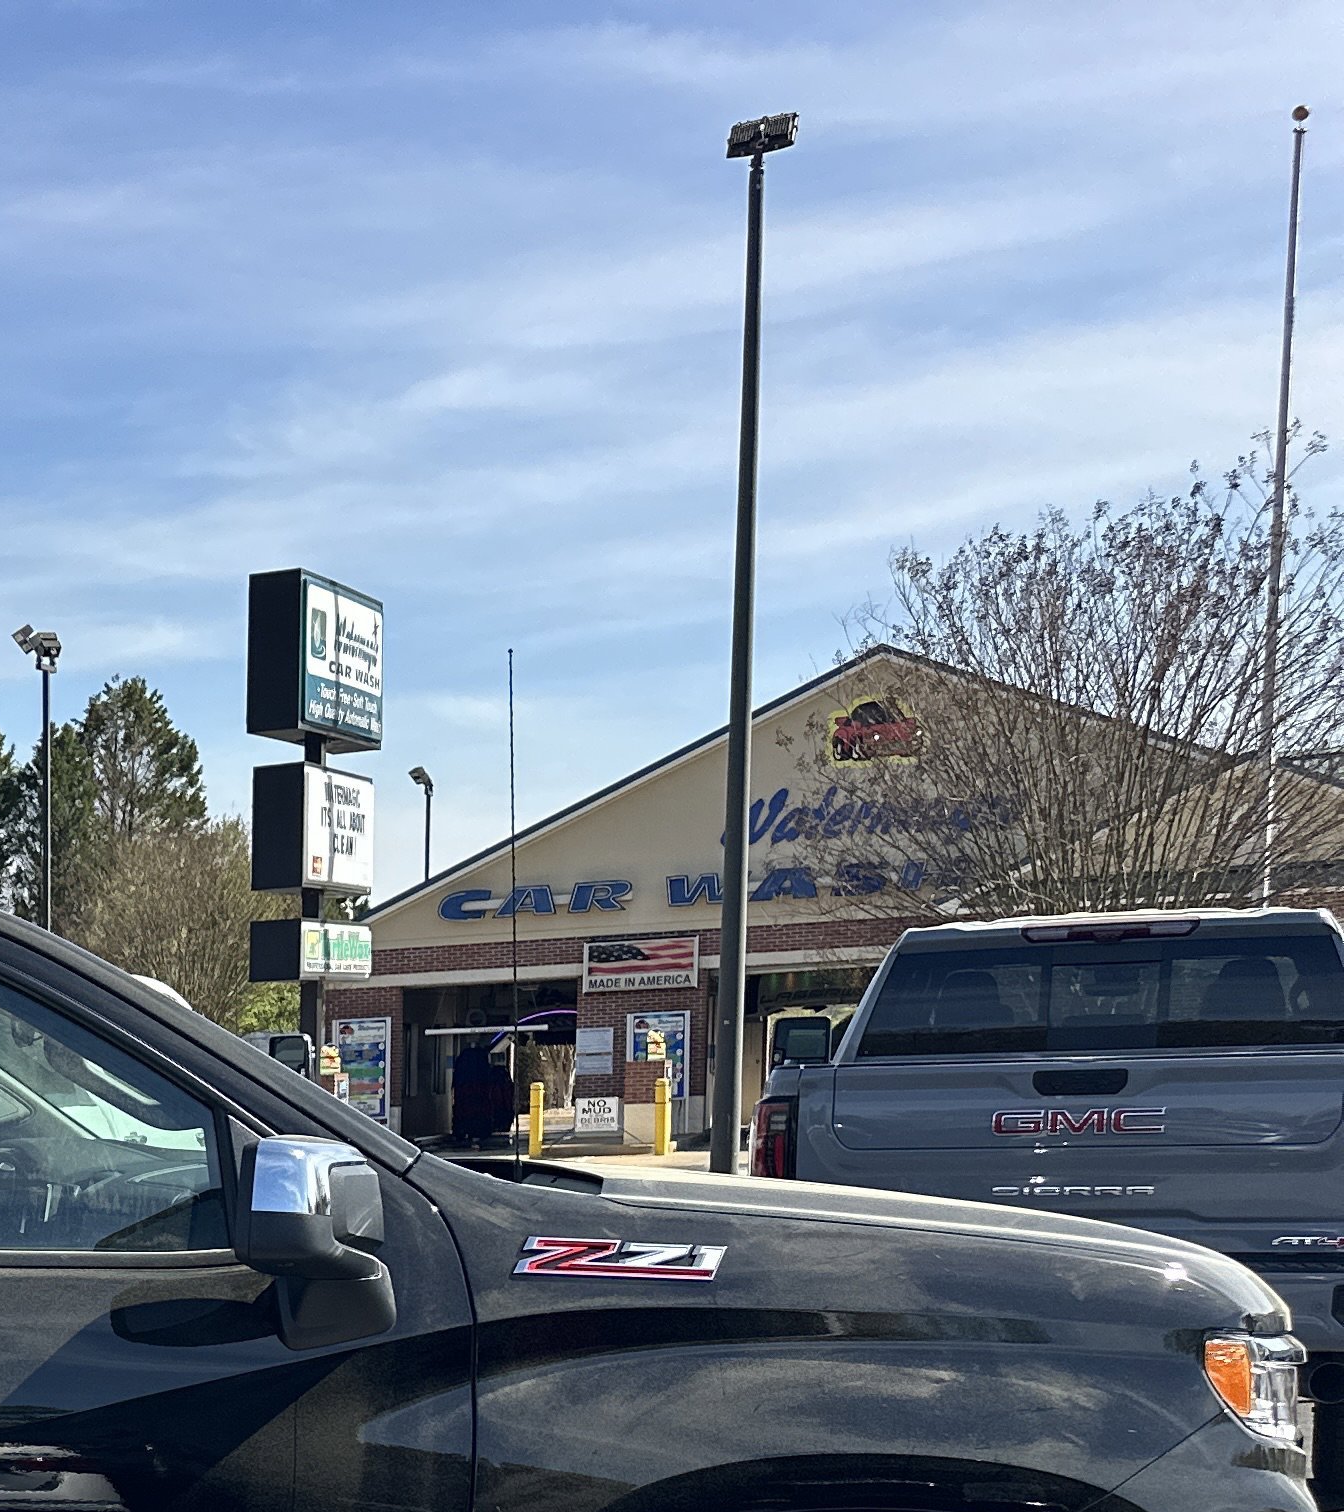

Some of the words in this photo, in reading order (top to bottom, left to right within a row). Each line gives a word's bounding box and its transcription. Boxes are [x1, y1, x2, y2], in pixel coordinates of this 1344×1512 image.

[329, 660, 352, 679] CAR
[355, 668, 380, 690] WASH
[337, 809, 347, 830] ALL
[349, 811, 365, 834] ABOUT
[438, 880, 632, 922] CAR
[588, 978, 621, 989] MADE
[625, 977, 635, 987] IN
[638, 974, 691, 986] AMERICA
[588, 1099, 606, 1107] NO
[992, 1107, 1167, 1136] GMC
[992, 1186, 1155, 1196] SIERRA
[513, 1236, 727, 1280] Z71
